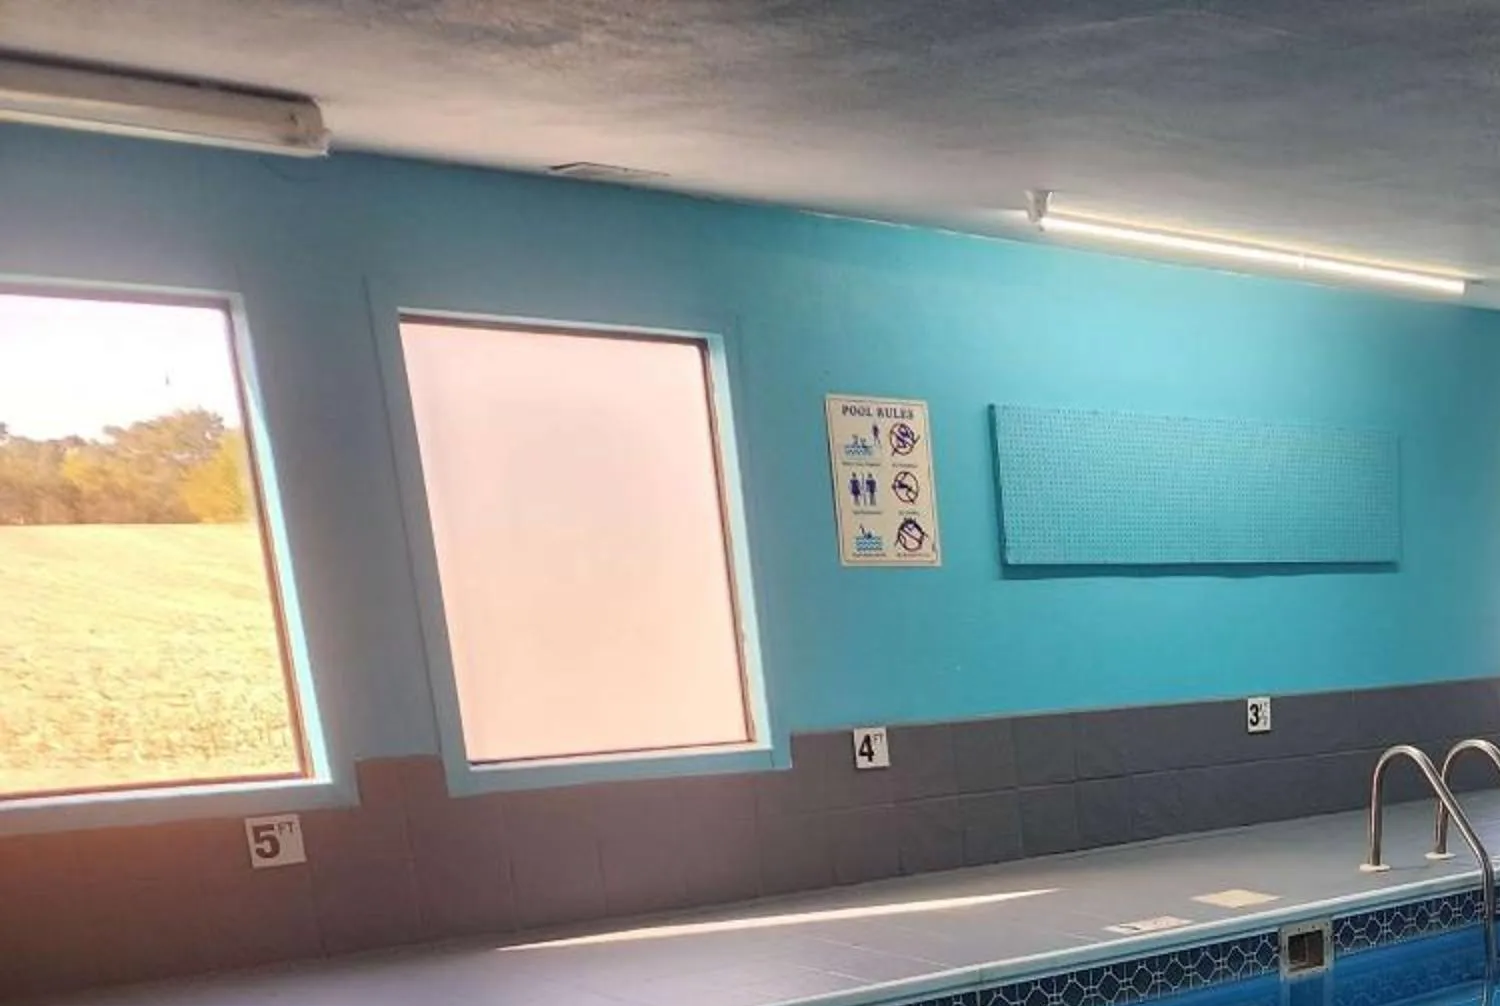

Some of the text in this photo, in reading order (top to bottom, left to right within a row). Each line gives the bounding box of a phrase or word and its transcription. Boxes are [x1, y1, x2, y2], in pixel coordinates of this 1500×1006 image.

[841, 404, 915, 420] POOL RULES
[1249, 703, 1260, 727] 3
[858, 733, 875, 763] 4
[251, 823, 281, 859] 5
